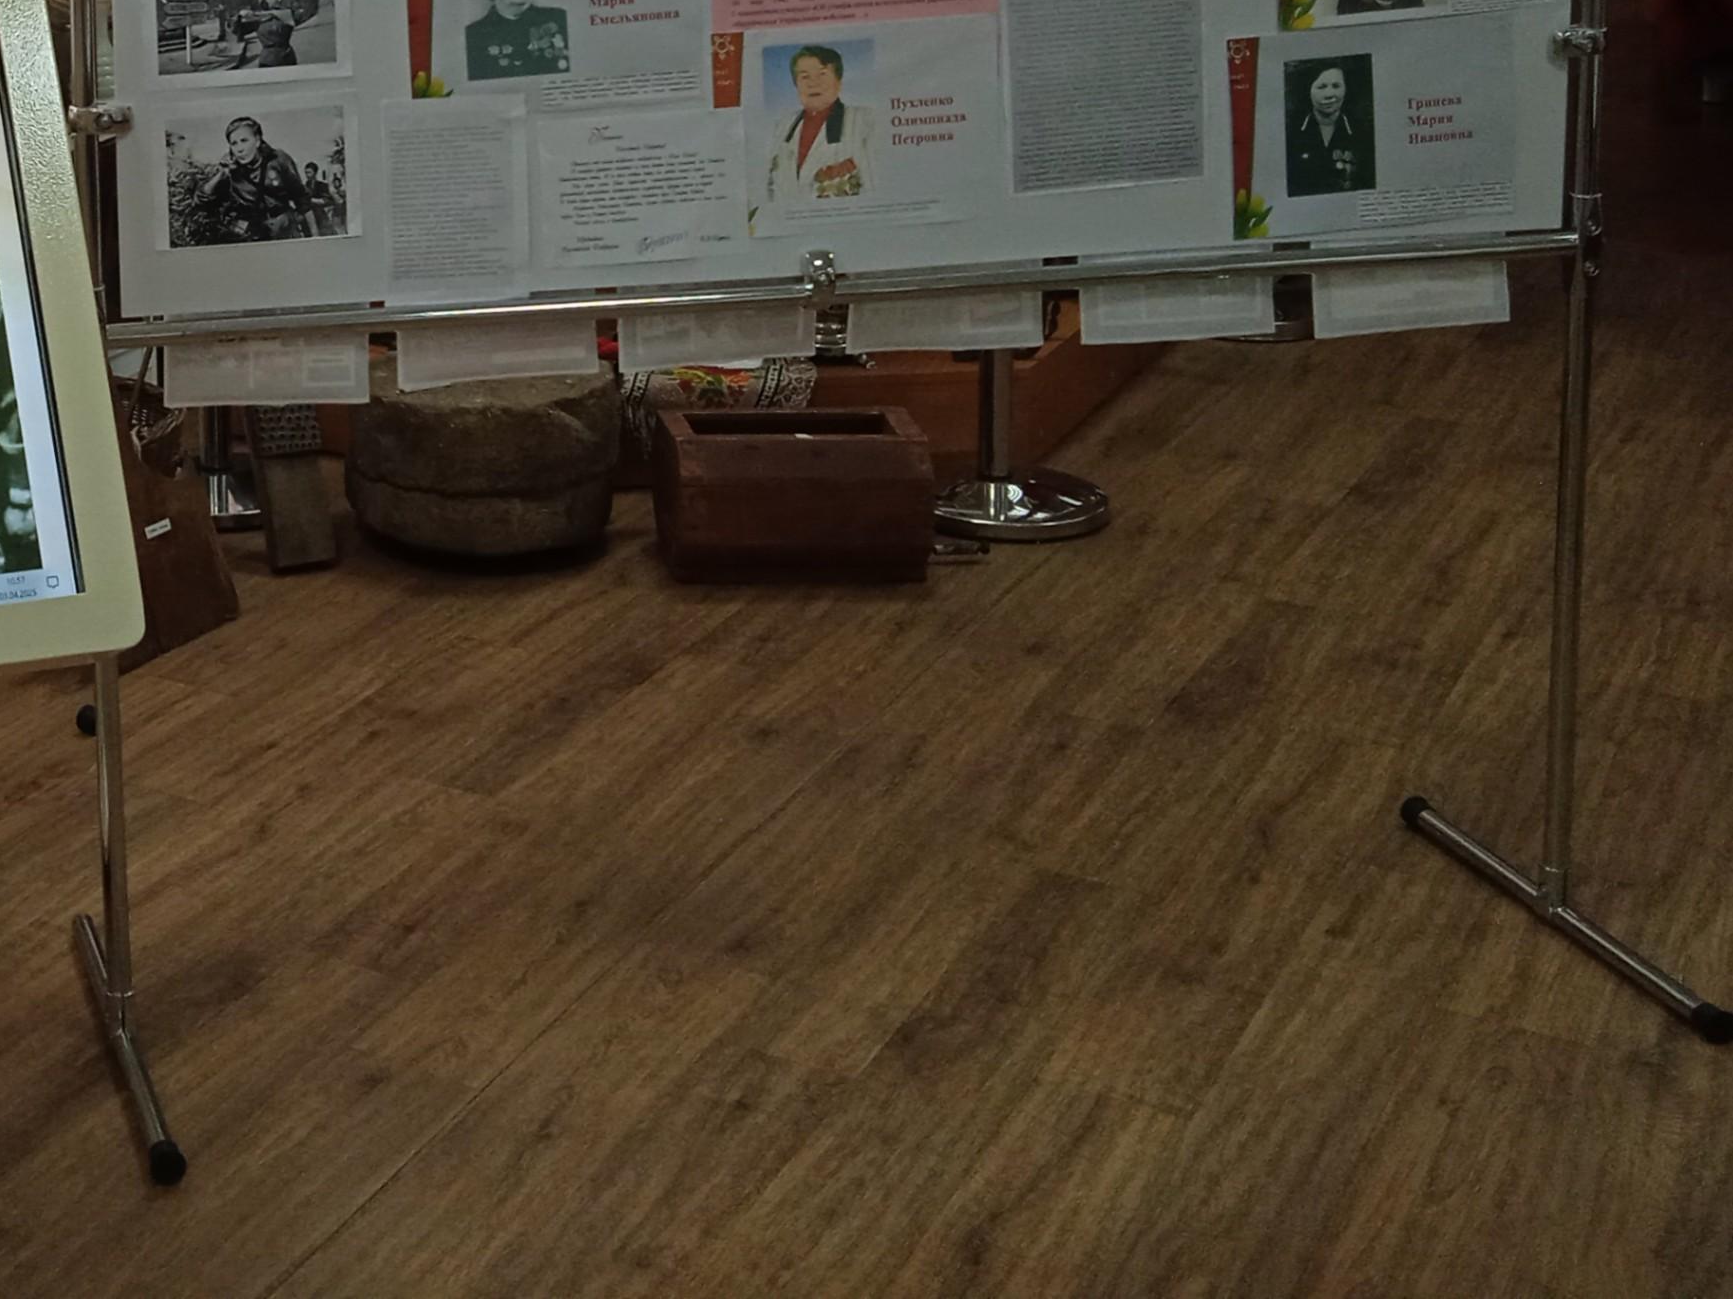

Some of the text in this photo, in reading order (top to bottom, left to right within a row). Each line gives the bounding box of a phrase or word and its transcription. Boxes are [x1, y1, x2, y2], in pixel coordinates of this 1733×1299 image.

[588, 8, 680, 27] Емельяновна
[890, 112, 967, 128] Олимпиада
[891, 131, 955, 147] Петровна
[1407, 130, 1474, 146] Ивановна
